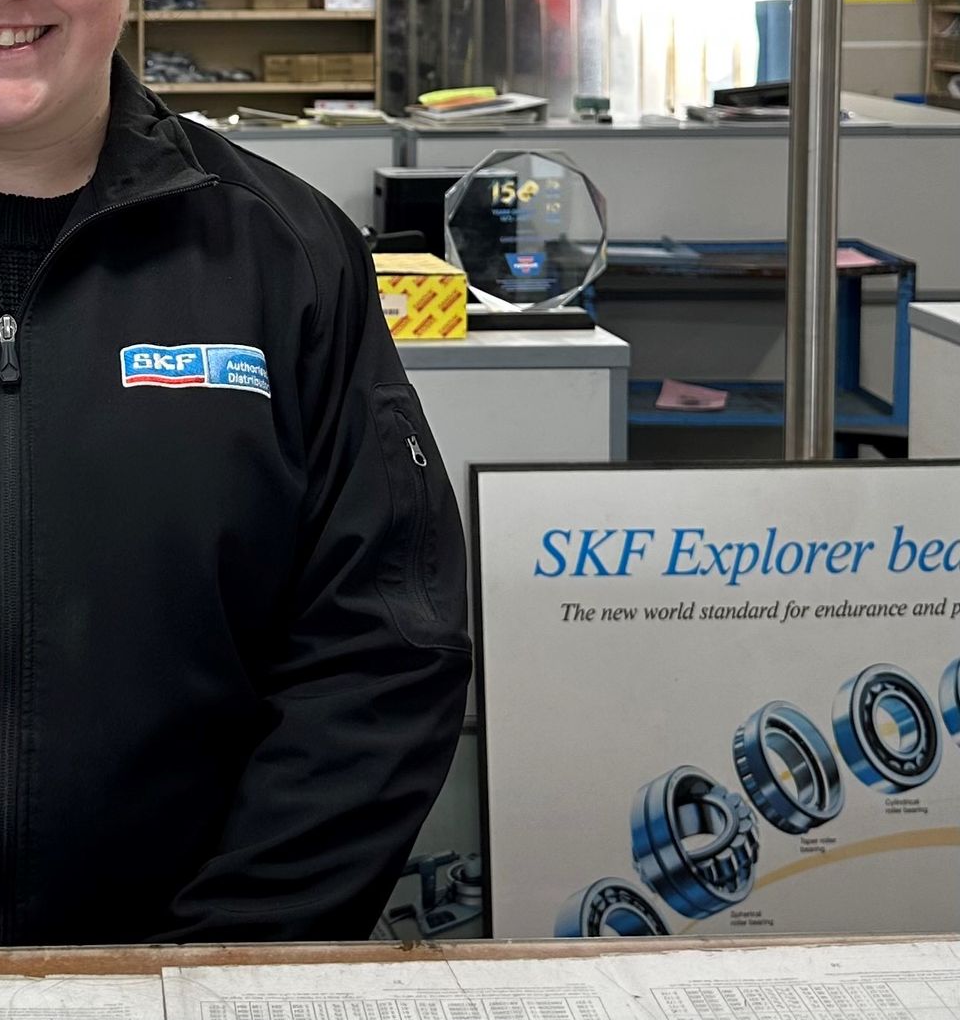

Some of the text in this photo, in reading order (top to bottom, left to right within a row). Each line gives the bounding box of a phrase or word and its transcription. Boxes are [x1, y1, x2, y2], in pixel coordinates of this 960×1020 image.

[133, 353, 197, 370] SKF
[534, 528, 655, 578] SKF
[661, 526, 874, 586] Explorer
[561, 603, 596, 621] The
[601, 607, 637, 620] new
[644, 601, 695, 620] world
[699, 600, 779, 620] standard
[780, 600, 809, 623] for
[815, 599, 907, 618] endurance
[913, 598, 947, 617] and
[903, 807, 928, 815] bearing
[749, 918, 774, 926] bearing
